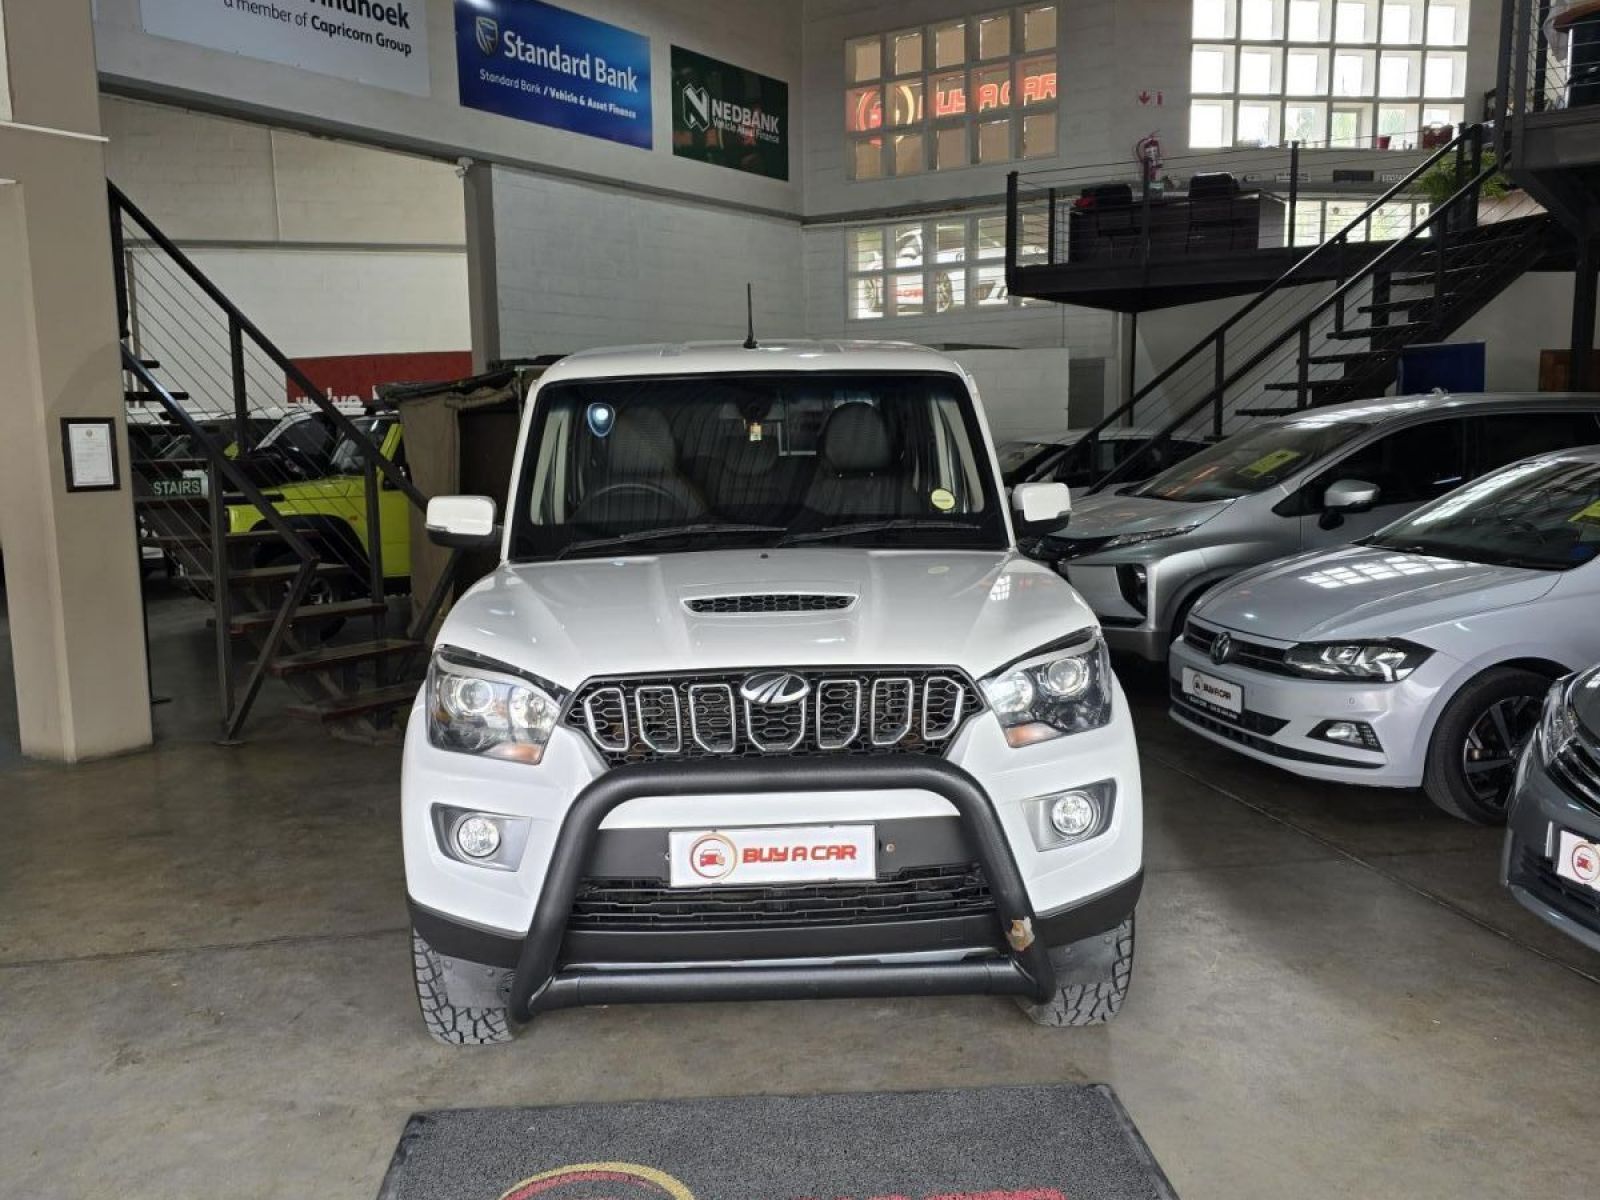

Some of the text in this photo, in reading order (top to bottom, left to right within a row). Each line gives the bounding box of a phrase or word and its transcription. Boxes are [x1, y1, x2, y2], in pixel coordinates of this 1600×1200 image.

[237, 0, 291, 23] member
[295, 12, 308, 27] of
[311, 15, 373, 44] Capricorn
[376, 32, 412, 57] Group
[503, 30, 639, 93] Standard Bank
[479, 68, 520, 90] Standard
[520, 80, 541, 95] Bank
[549, 87, 578, 104] Vehicle
[579, 95, 586, 106] &
[587, 98, 608, 112] Asset
[608, 103, 637, 119] Finance
[711, 98, 779, 134] NEDBANK
[153, 480, 201, 495] STAIRS
[742, 844, 857, 863] BUY A CAR
